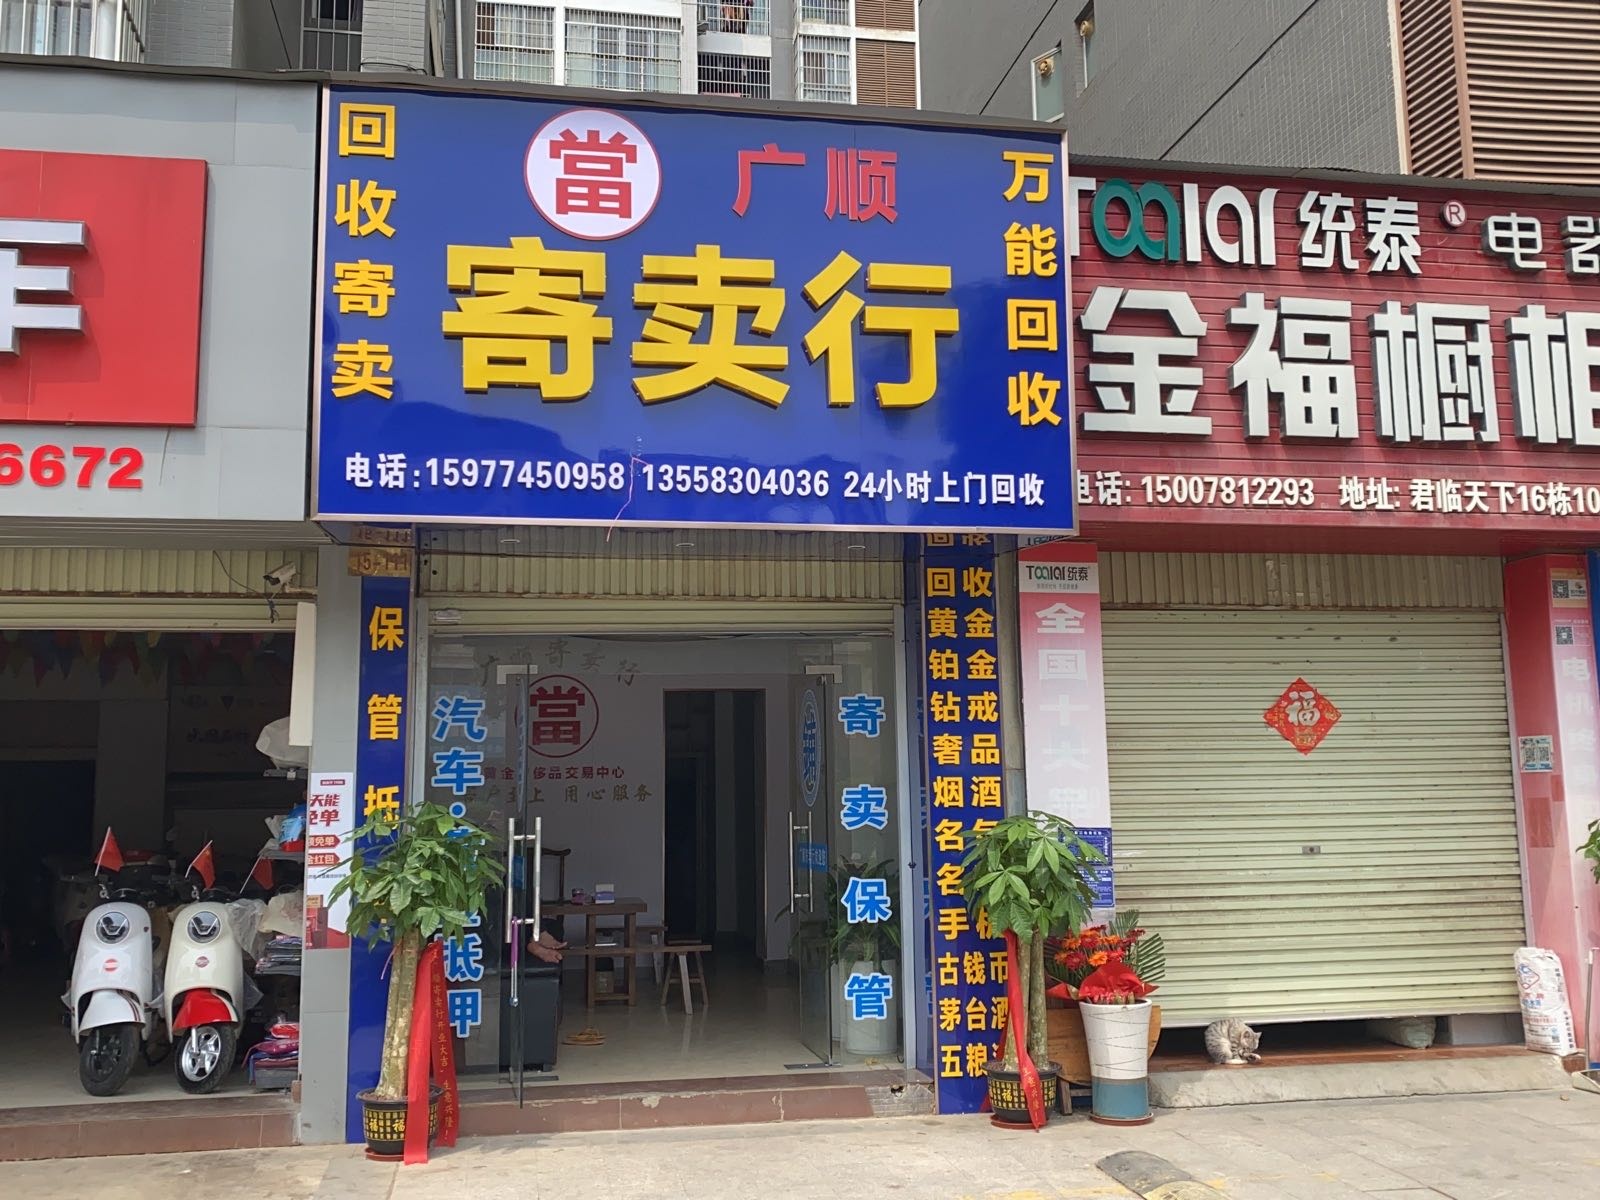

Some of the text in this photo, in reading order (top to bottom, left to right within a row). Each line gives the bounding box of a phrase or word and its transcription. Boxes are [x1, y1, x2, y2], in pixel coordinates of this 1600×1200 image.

[549, 128, 638, 219] 當
[732, 143, 898, 223] 广顺
[333, 102, 397, 400] 回收寄卖
[1002, 150, 1063, 427] 万能回收
[441, 236, 960, 408] 寄卖行
[642, 463, 830, 497] 13558304036
[843, 468, 1045, 506] 24小时上门回收
[1139, 475, 1315, 507] 15007812293
[927, 567, 993, 598] 回收
[927, 607, 995, 638] 黄金
[929, 649, 997, 681] 铂金
[930, 690, 999, 723] 钻戒
[932, 733, 1001, 766] 奢品
[932, 775, 1002, 808] 烟酒
[838, 693, 893, 1021] 寄卖保管
[941, 1042, 999, 1079] 五粮
